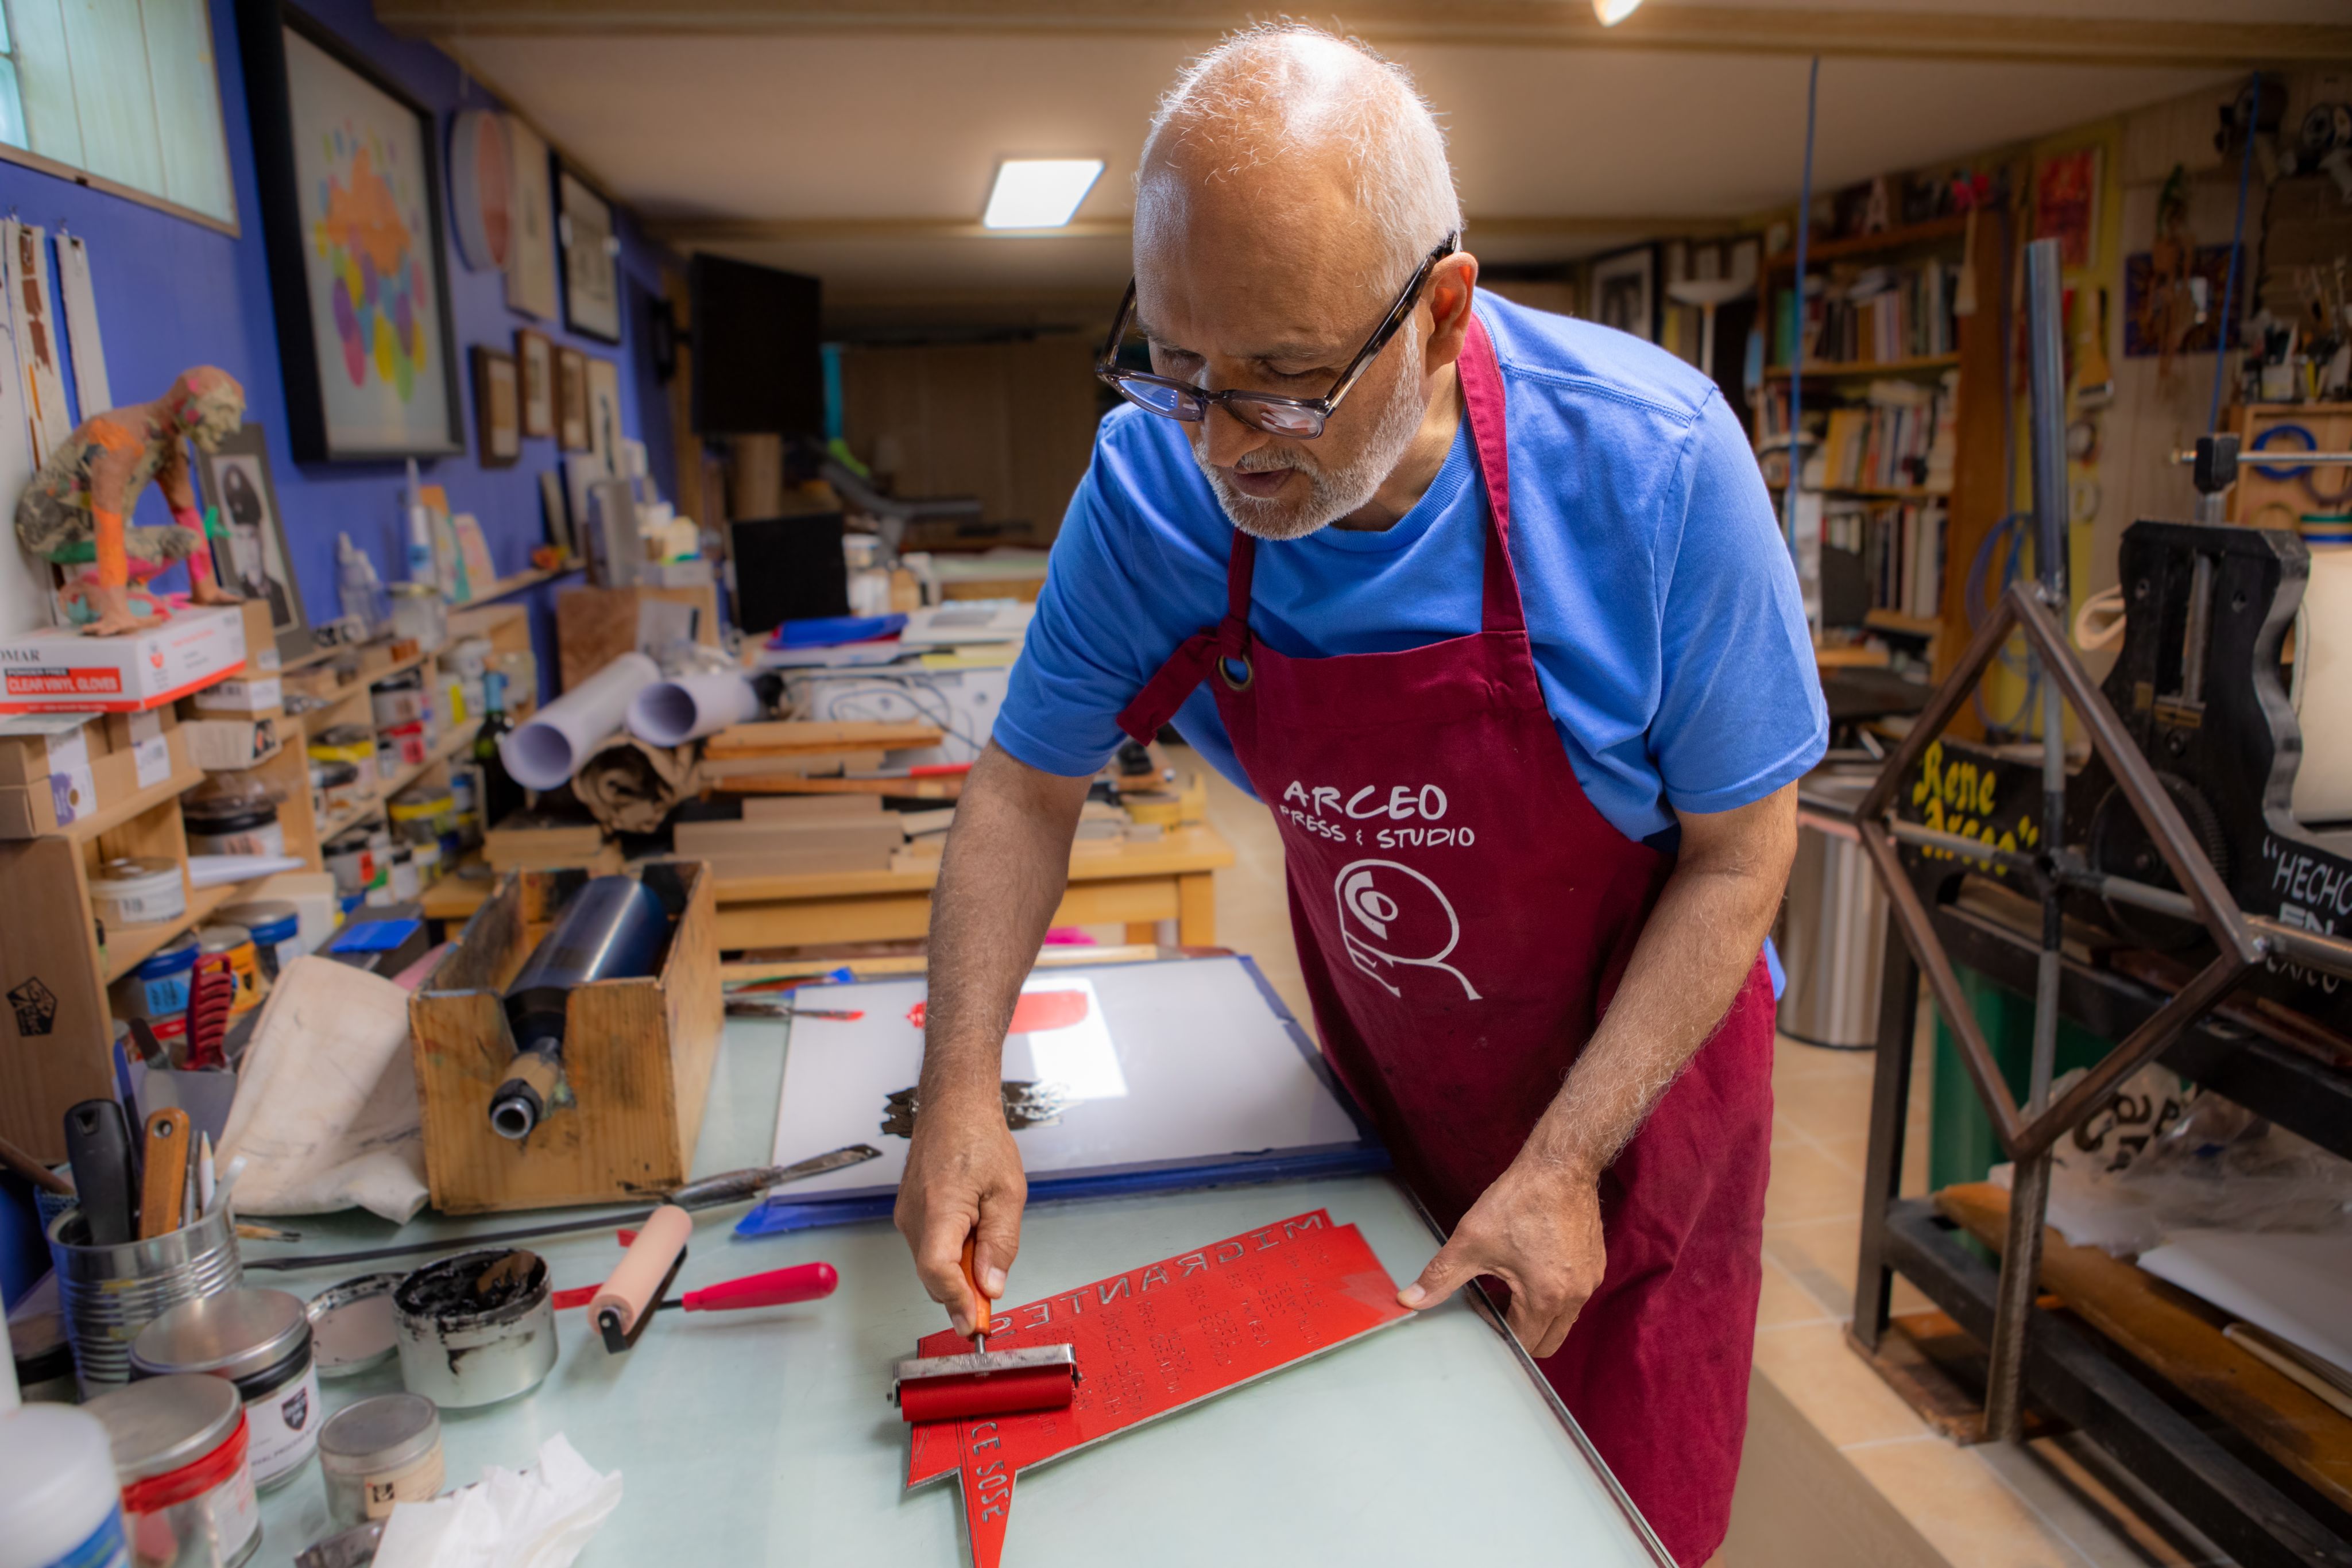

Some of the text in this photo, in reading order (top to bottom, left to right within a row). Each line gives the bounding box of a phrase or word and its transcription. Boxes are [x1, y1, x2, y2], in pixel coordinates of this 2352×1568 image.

[9, 676, 118, 691] CLEAR VINYL GLOVES
[1283, 780, 1448, 820] ARCEO
[1279, 805, 1347, 842] PRESS
[1376, 827, 1475, 849] STUDIO
